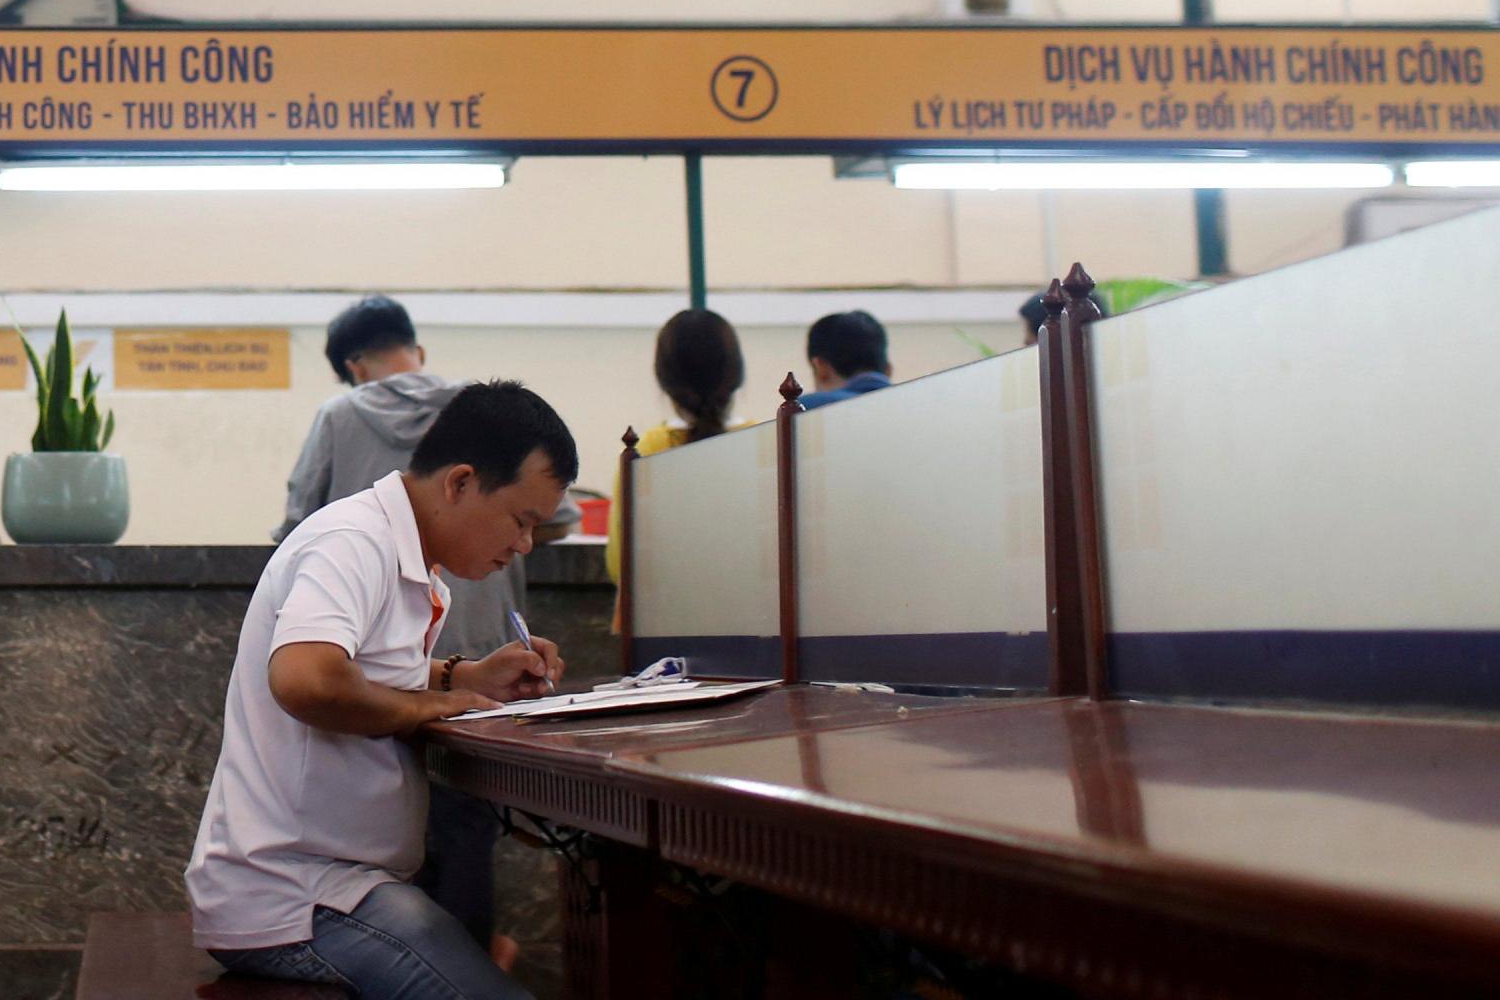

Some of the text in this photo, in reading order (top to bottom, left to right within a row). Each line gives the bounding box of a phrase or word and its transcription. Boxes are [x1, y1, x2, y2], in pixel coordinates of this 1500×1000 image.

[57, 41, 166, 84] CHÍNH
[180, 39, 274, 84] CÔNG
[1043, 39, 1484, 88] DỊCH VỤ HÀNH CHÍNH CÔNG
[729, 69, 756, 109] 7
[22, 96, 93, 130] CÔNG
[122, 101, 173, 130] THU
[183, 101, 257, 130] BHXH
[287, 93, 339, 130] BẢO
[348, 90, 415, 130] HIỂM
[425, 101, 440, 129] Y
[450, 92, 485, 130] TẾ
[1051, 97, 1117, 130] PHÁP
[1378, 97, 1441, 131] PHÁT
